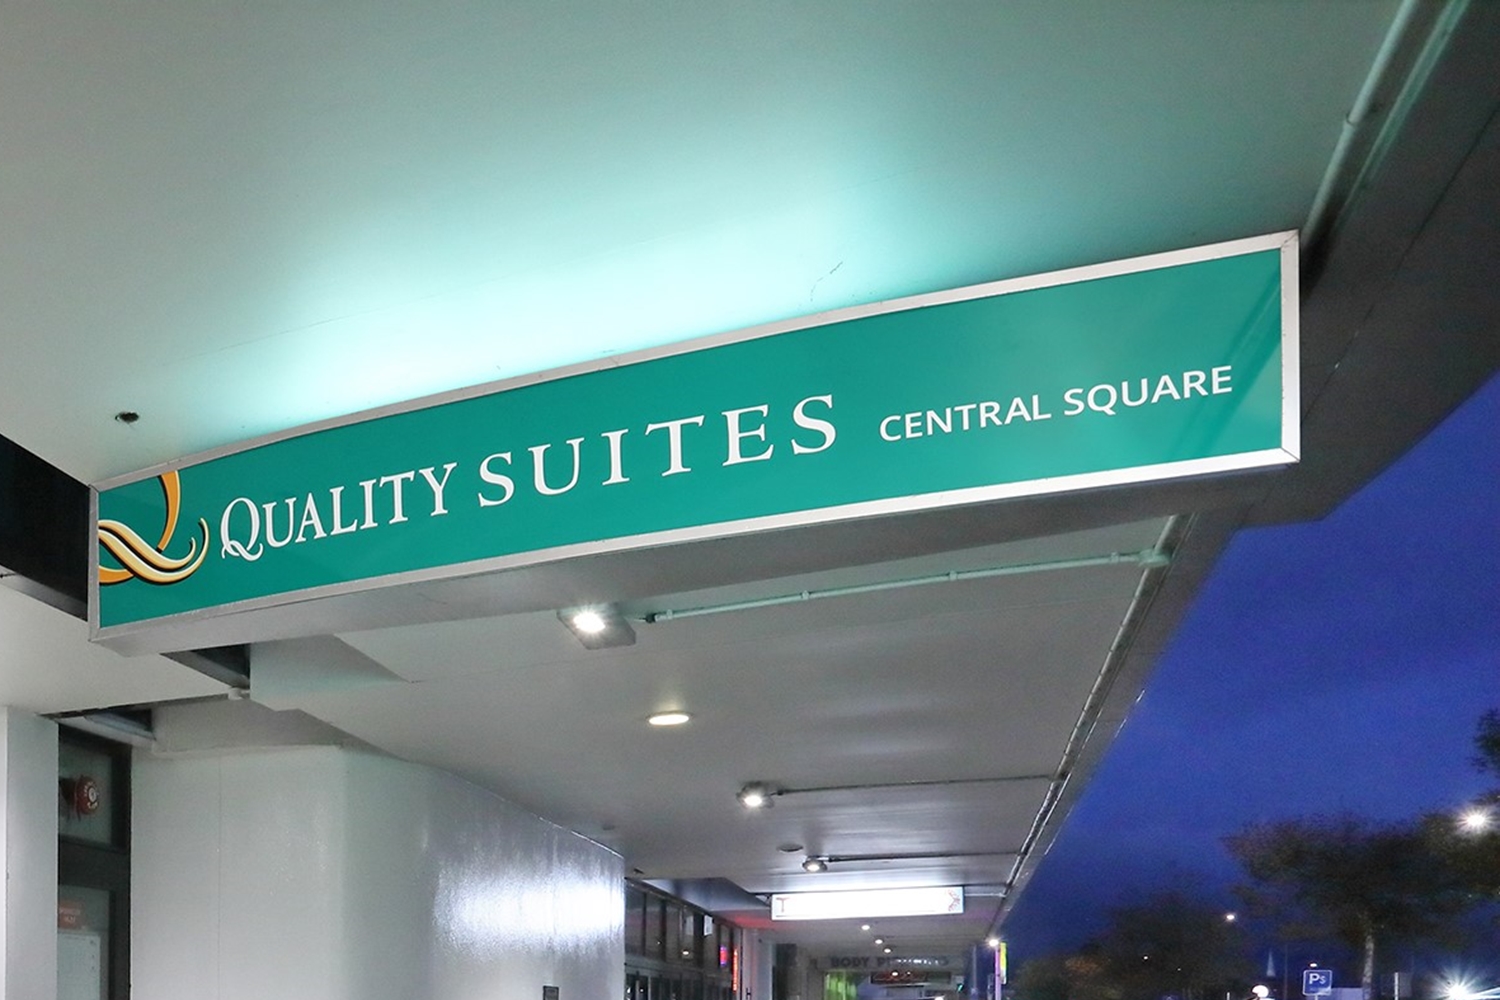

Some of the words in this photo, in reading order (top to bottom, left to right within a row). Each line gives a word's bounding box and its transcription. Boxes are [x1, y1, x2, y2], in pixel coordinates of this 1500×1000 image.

[220, 462, 458, 562] QUALITY
[477, 394, 837, 508] SUITES
[879, 394, 1052, 442] CENTRAL
[1063, 365, 1233, 417] SQUARE
